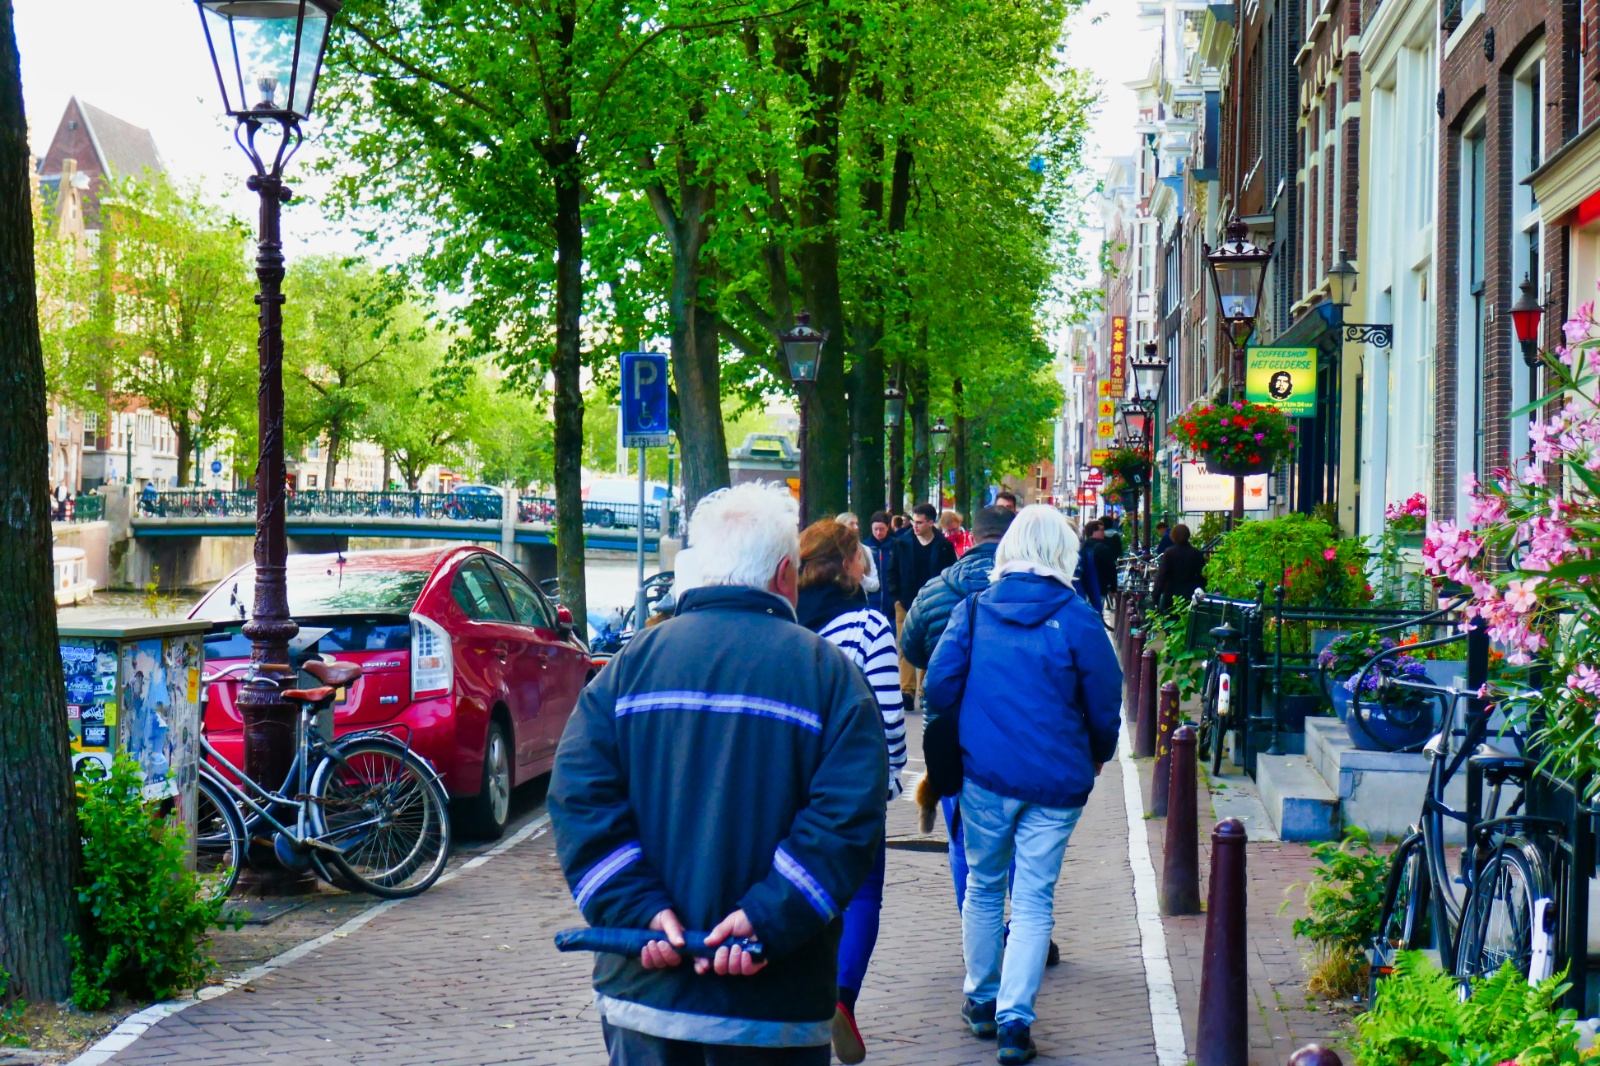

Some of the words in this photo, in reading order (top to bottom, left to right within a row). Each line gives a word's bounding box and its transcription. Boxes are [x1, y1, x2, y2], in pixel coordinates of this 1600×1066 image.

[1256, 350, 1308, 358] COFFEESHOP
[1250, 360, 1269, 370] HET
[1269, 360, 1312, 370] GELDERSE
[634, 360, 658, 400] P
